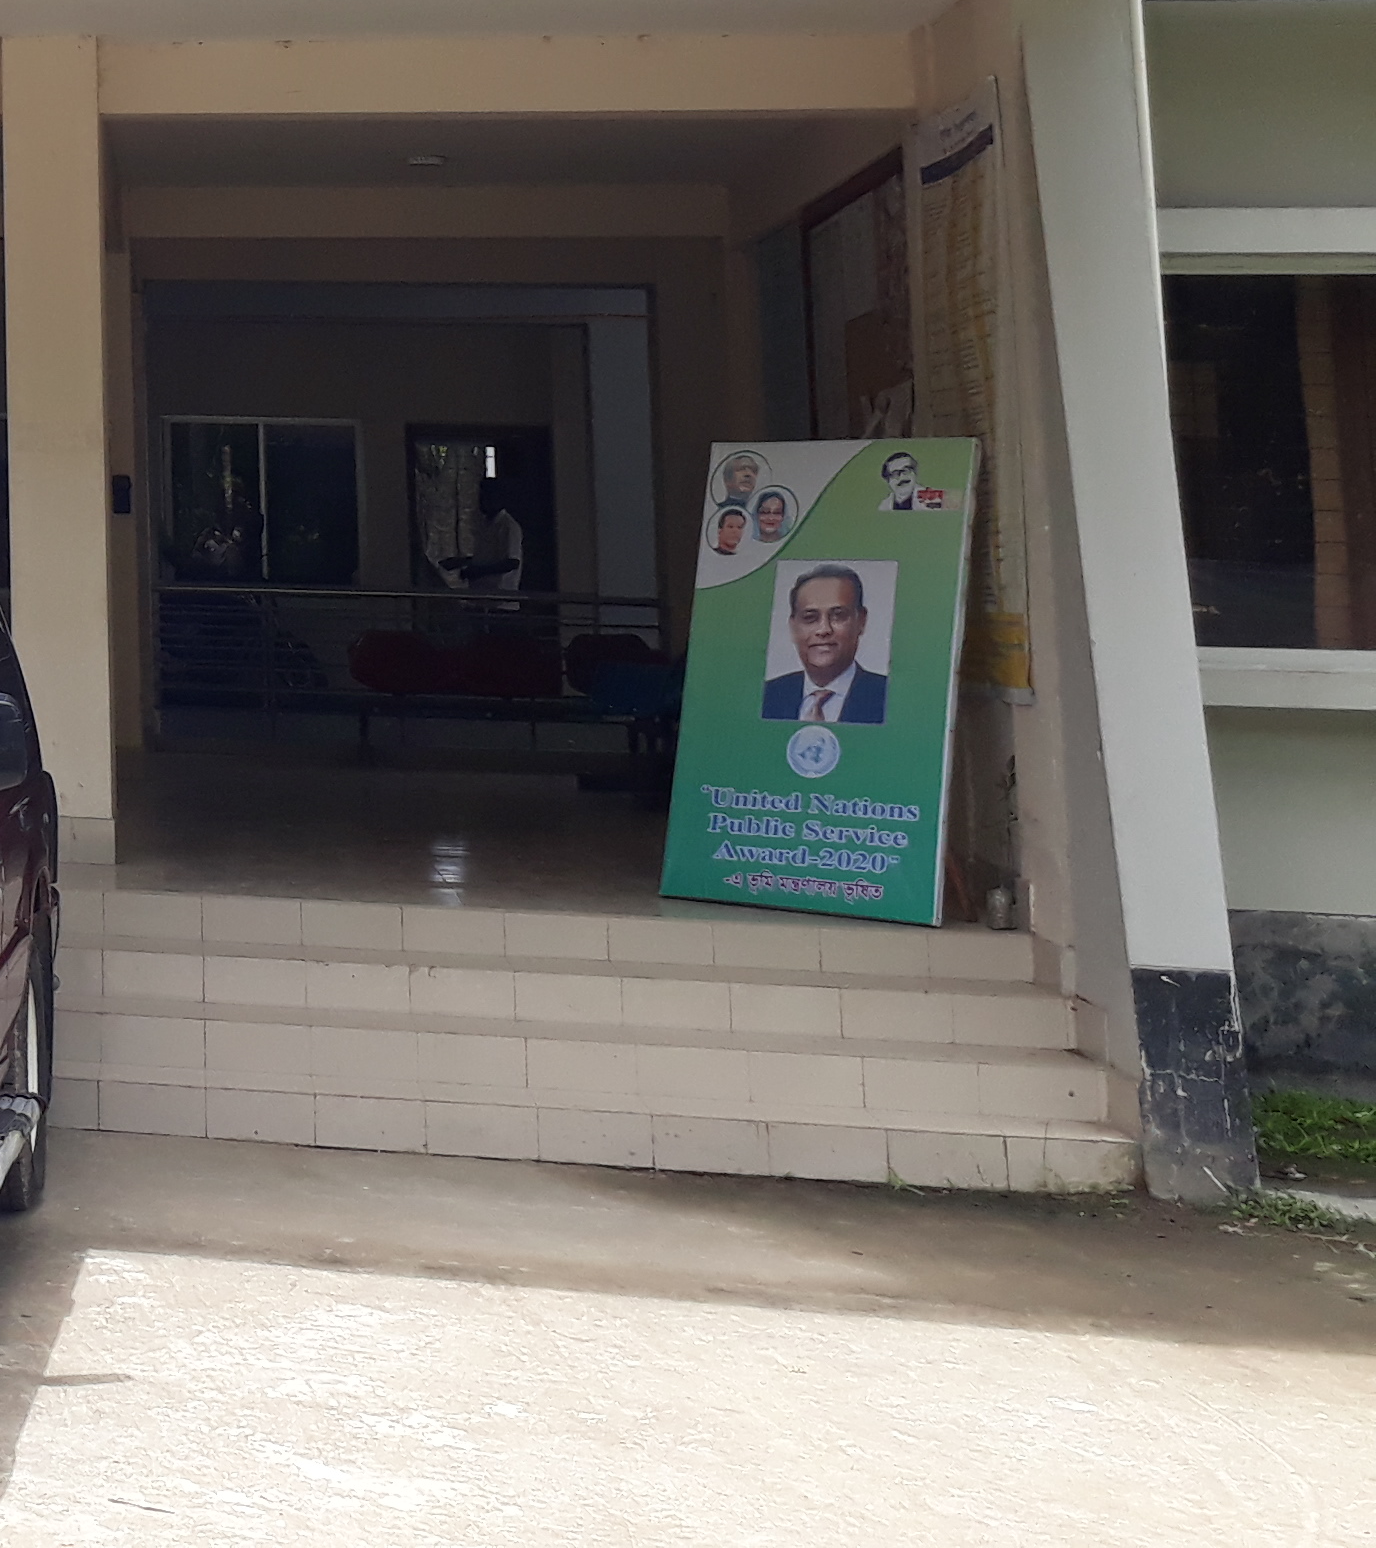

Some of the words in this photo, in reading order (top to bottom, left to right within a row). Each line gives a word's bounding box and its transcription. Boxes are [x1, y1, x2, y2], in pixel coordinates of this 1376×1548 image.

[808, 793, 920, 822] Nations
[707, 813, 796, 839] Public
[802, 819, 909, 847] Service
[747, 870, 774, 895] ভূমি
[842, 878, 884, 905] ভূষিত
